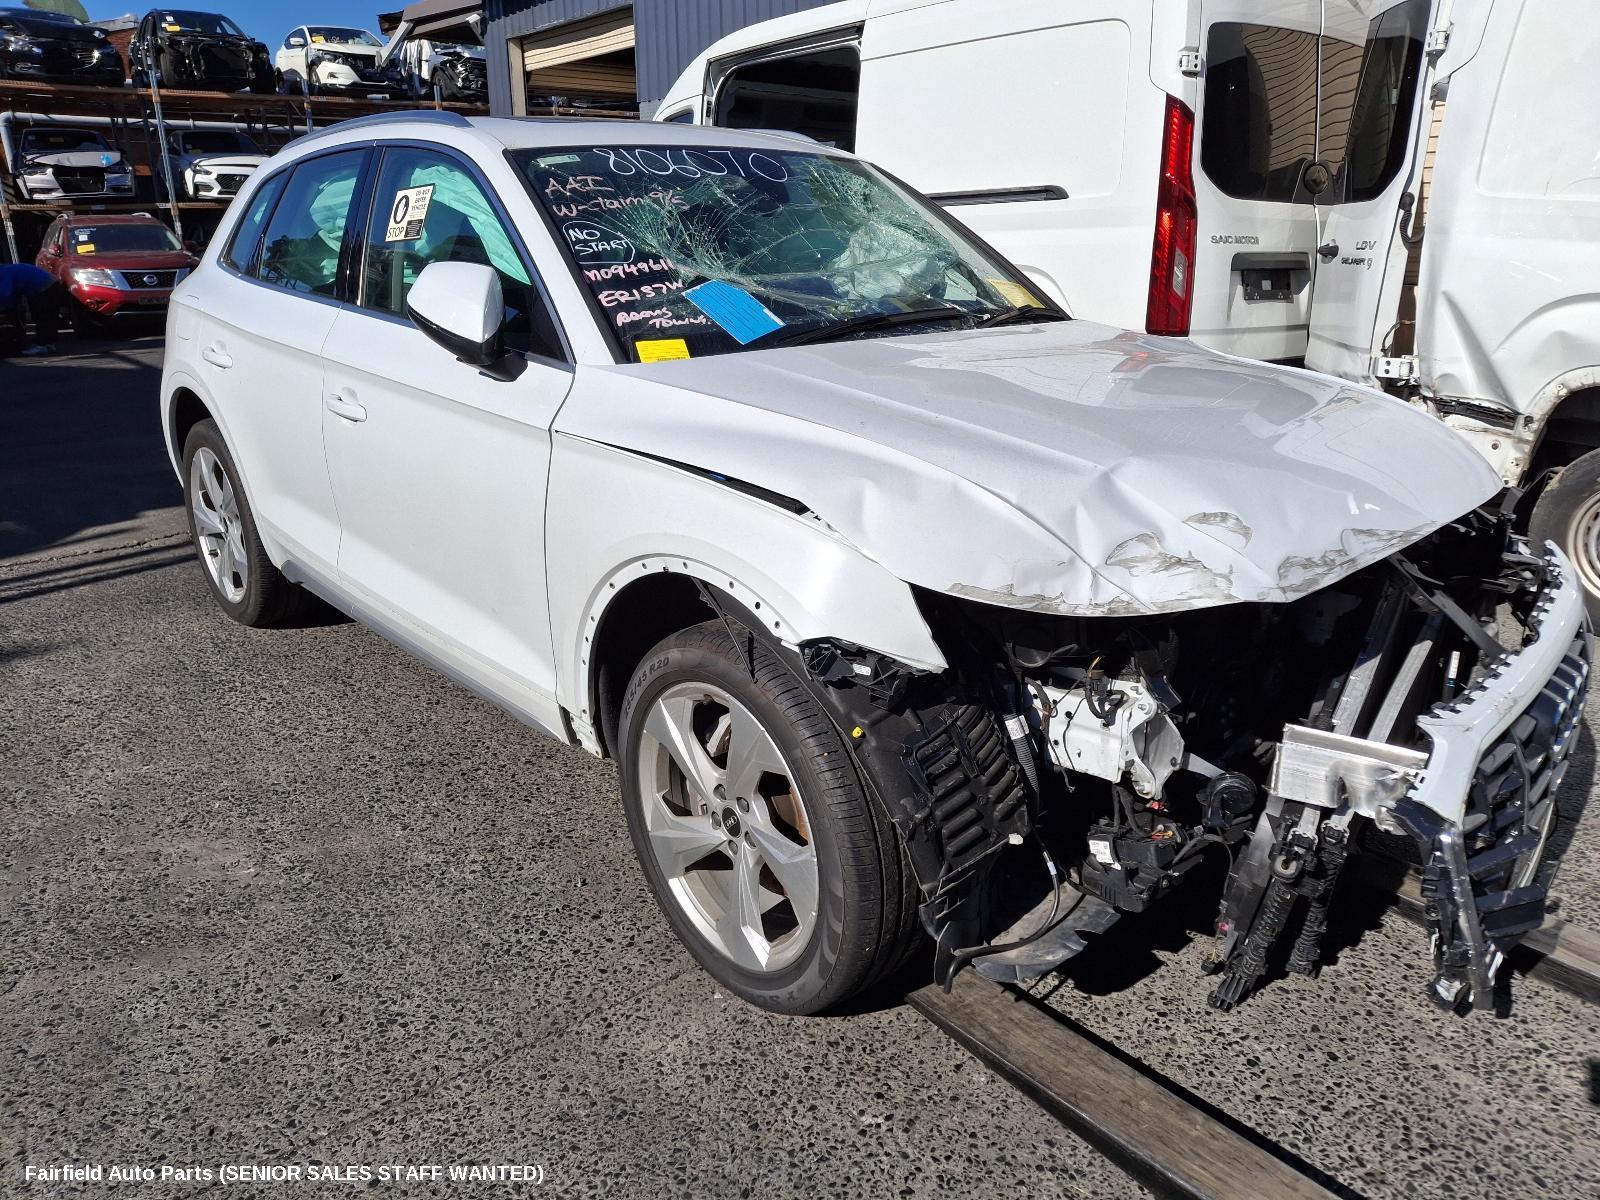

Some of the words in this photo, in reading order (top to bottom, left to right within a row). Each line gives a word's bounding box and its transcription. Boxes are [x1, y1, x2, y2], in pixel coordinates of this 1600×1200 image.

[593, 148, 788, 182] 8106070
[388, 226, 404, 239] STOP
[568, 227, 601, 242] NO
[574, 238, 629, 256] START
[1356, 240, 1376, 250] LDV
[648, 656, 670, 676] R20
